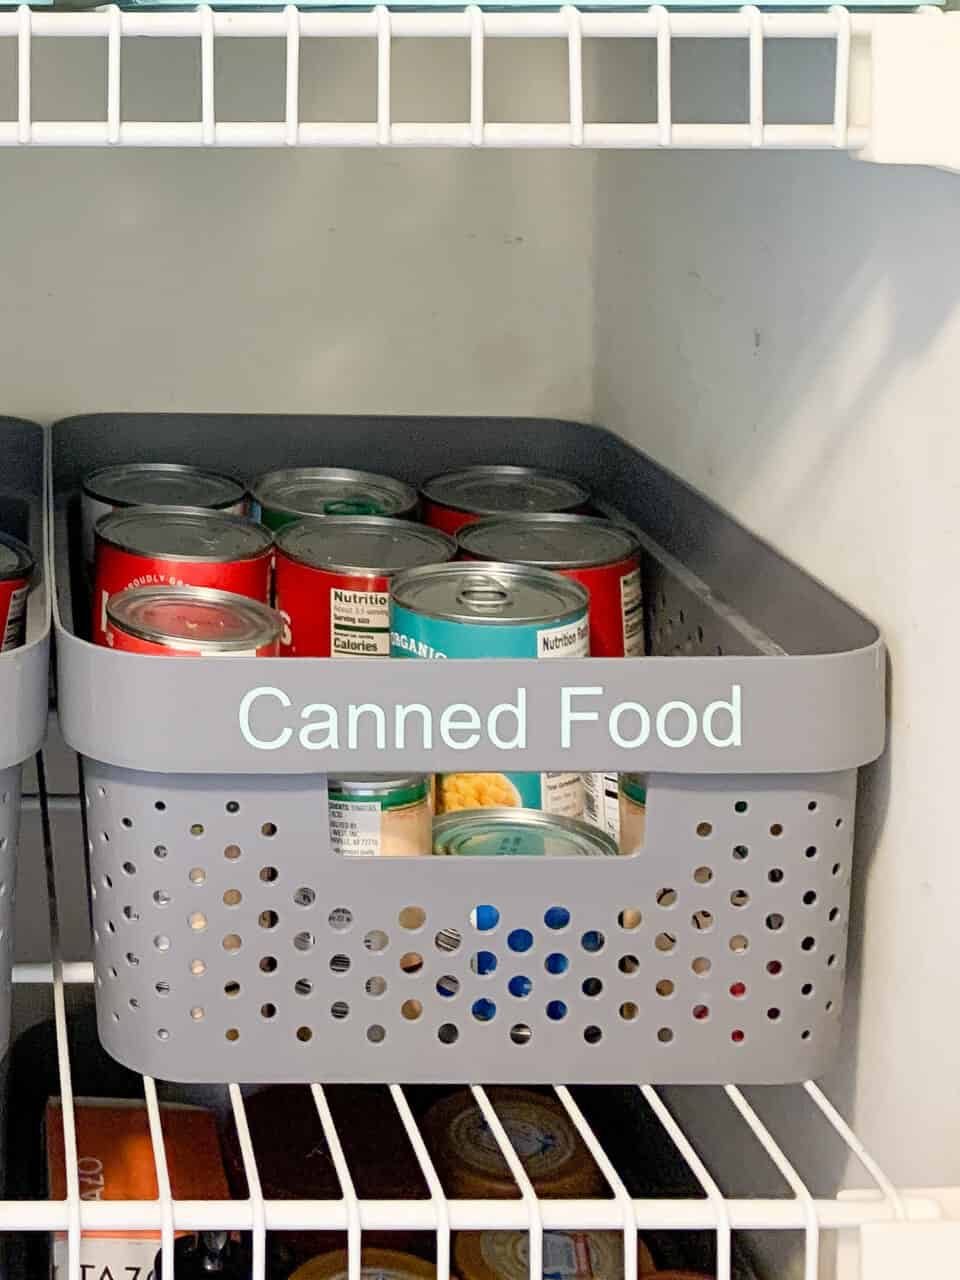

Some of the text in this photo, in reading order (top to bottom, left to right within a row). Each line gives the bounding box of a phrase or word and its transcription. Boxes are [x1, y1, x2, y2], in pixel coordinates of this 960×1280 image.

[334, 590, 387, 605] Nutritio
[333, 637, 379, 652] Calories
[543, 632, 577, 652] Nutrition
[239, 684, 744, 751] Canned Food
